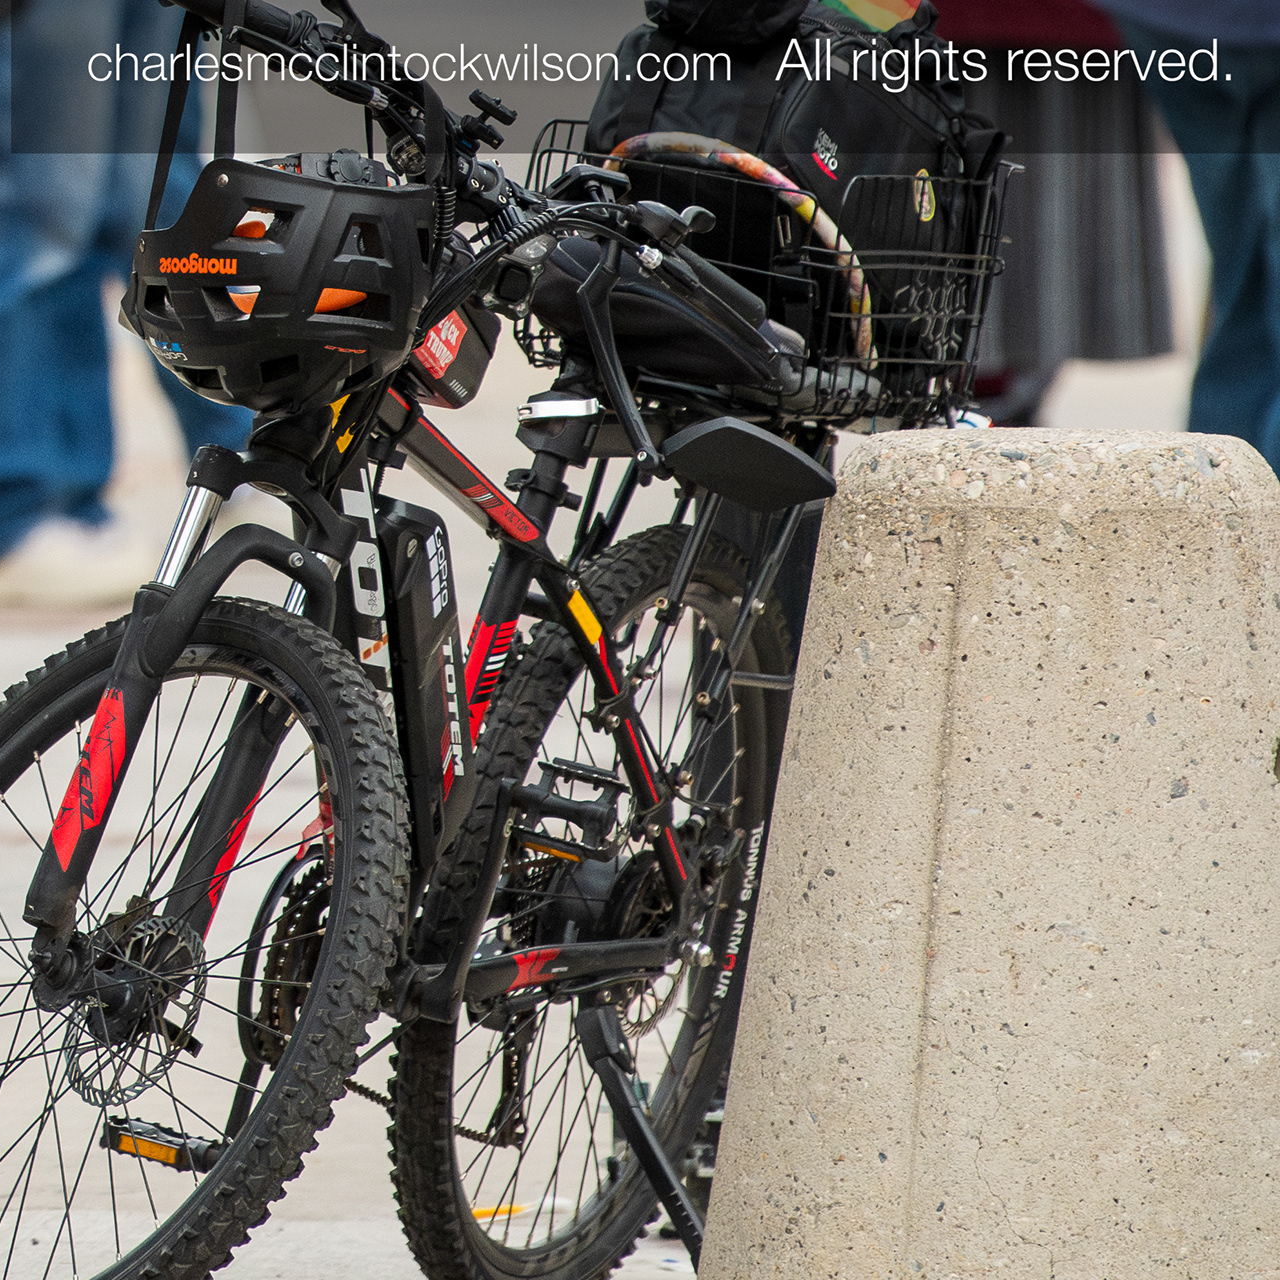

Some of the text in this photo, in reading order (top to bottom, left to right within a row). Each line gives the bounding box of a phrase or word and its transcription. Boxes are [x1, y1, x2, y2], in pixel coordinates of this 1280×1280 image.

[159, 252, 238, 275] mongoose
[426, 330, 454, 368] TRUMP
[435, 524, 449, 608] GoPro
[442, 636, 465, 777] TOTEM
